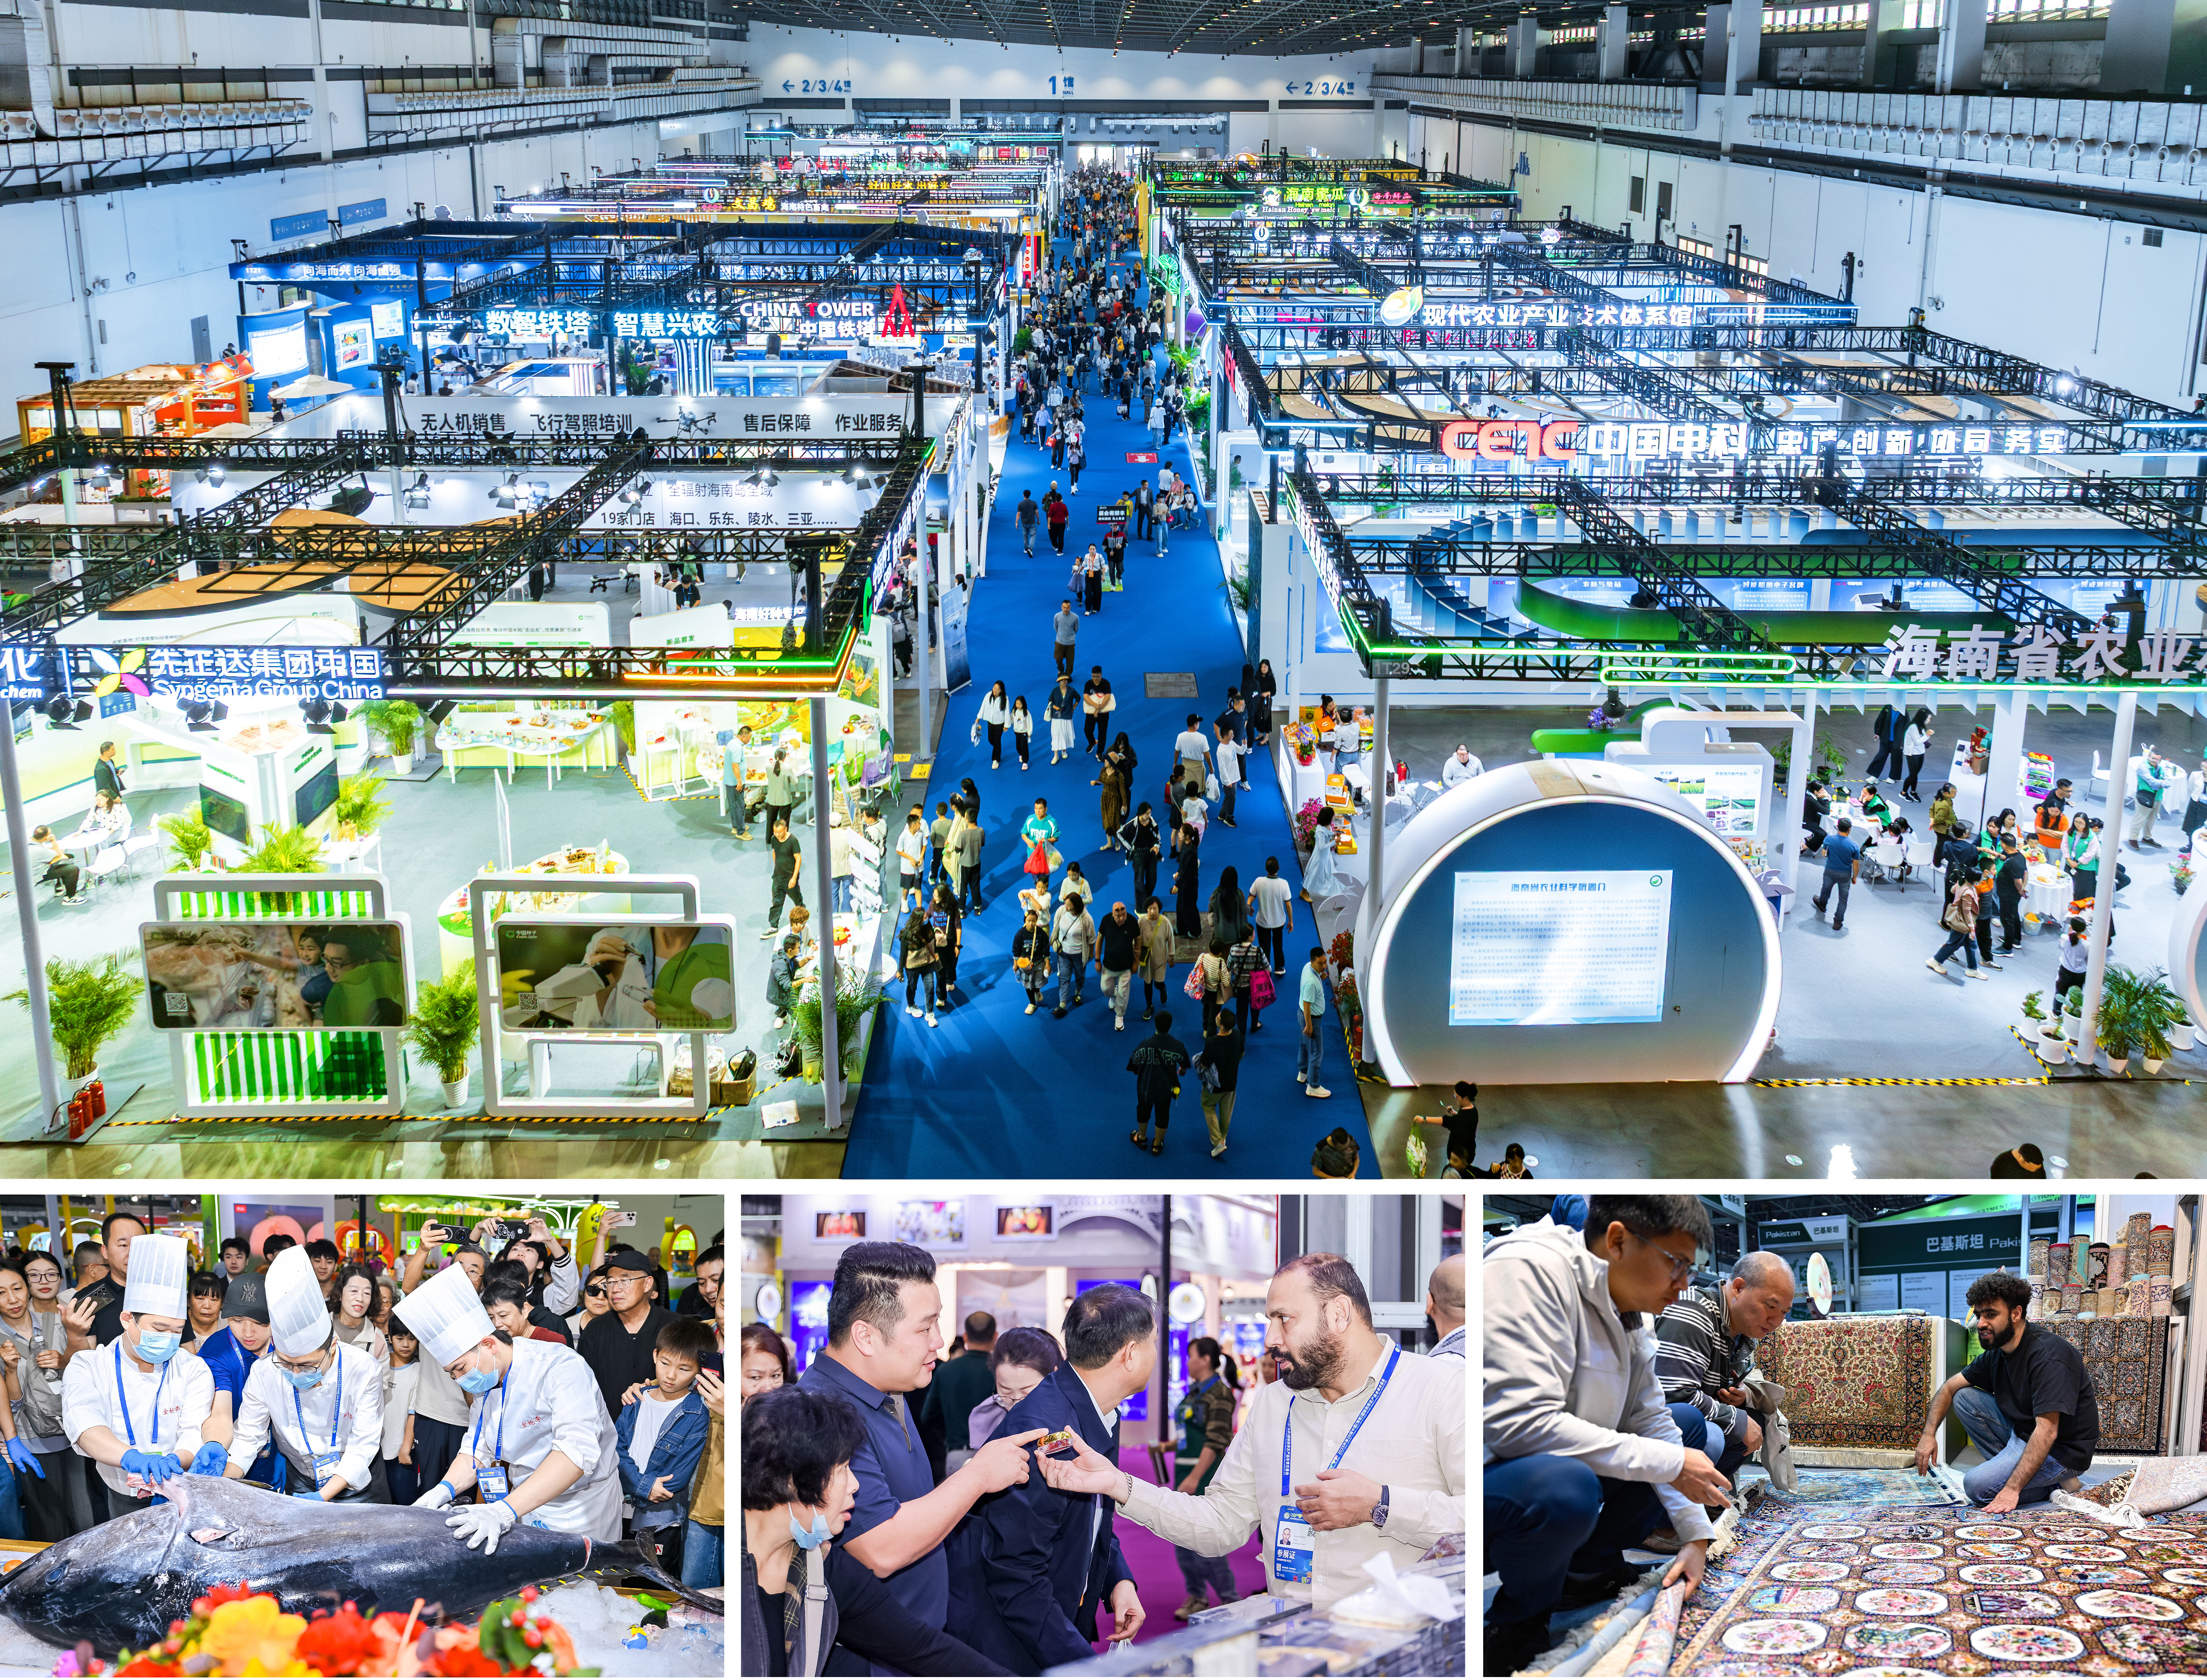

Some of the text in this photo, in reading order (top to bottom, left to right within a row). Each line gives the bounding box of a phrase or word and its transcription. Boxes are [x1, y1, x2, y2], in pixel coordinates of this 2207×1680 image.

[802, 80, 842, 92] 2/3/4
[1049, 76, 1056, 95] 1
[1063, 76, 1074, 87] 馆
[1304, 82, 1345, 95] 2/3/4
[1286, 187, 1344, 200] 海南蜜瓜
[731, 196, 777, 212] 文昌鸡
[780, 203, 829, 212] 海南特色畜禽
[303, 265, 351, 276] 向海而兴
[740, 303, 875, 316] CHINA TOWER
[486, 311, 719, 337] 数智铁塔 智慧兴农
[799, 321, 875, 338] 中国铁塔
[421, 412, 506, 432] 无人机销售
[530, 413, 632, 432] 飞行驾照培训
[743, 414, 811, 432] 售后保障
[835, 414, 903, 432] 作业服务
[1442, 421, 1579, 460] CETC
[1587, 422, 1748, 462] 中国电科
[1852, 429, 1912, 456] 创新
[1930, 427, 1990, 454] 协同
[2004, 428, 2066, 455] 务实
[601, 511, 655, 526] 19家门店
[666, 634, 695, 645] 新品首发
[1882, 624, 2207, 680] 海南省农业
[151, 648, 381, 680] 先正达集团中国
[1374, 662, 1410, 675] 1T29
[153, 680, 383, 703] Syngenta Group China
[1765, 1230, 1800, 1239] Pakistan
[1814, 1225, 1839, 1235] 巴基斯坦
[1927, 1234, 1984, 1252] 巴基斯坦
[521, 1415, 543, 1428] 金枪李
[1277, 1549, 1296, 1559] 参展证
